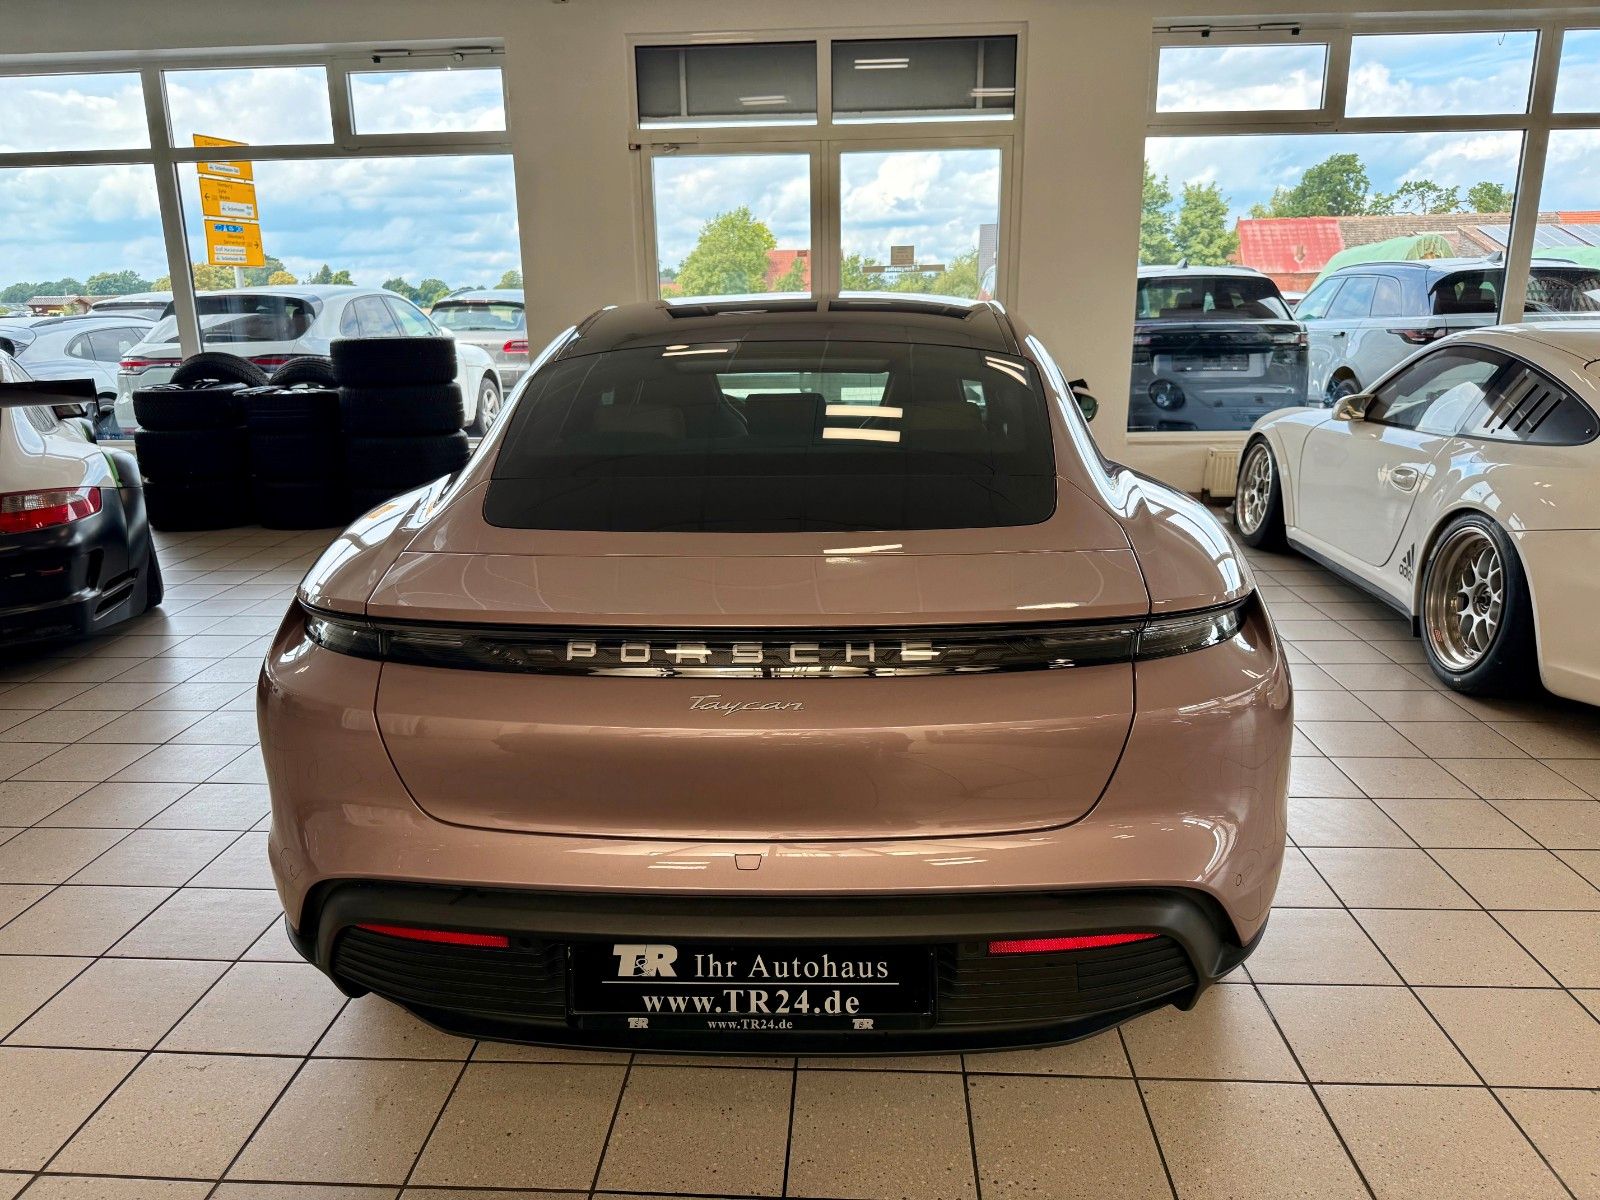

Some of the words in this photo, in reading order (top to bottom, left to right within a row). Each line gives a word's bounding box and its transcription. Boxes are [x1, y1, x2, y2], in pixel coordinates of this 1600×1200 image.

[566, 641, 937, 663] PORSCHE
[689, 695, 805, 717] Taycan
[694, 954, 738, 978] Ihr
[749, 955, 888, 978] Autohaus
[642, 990, 860, 1014] www.TR24.de
[707, 1018, 793, 1030] www.TR24.de
